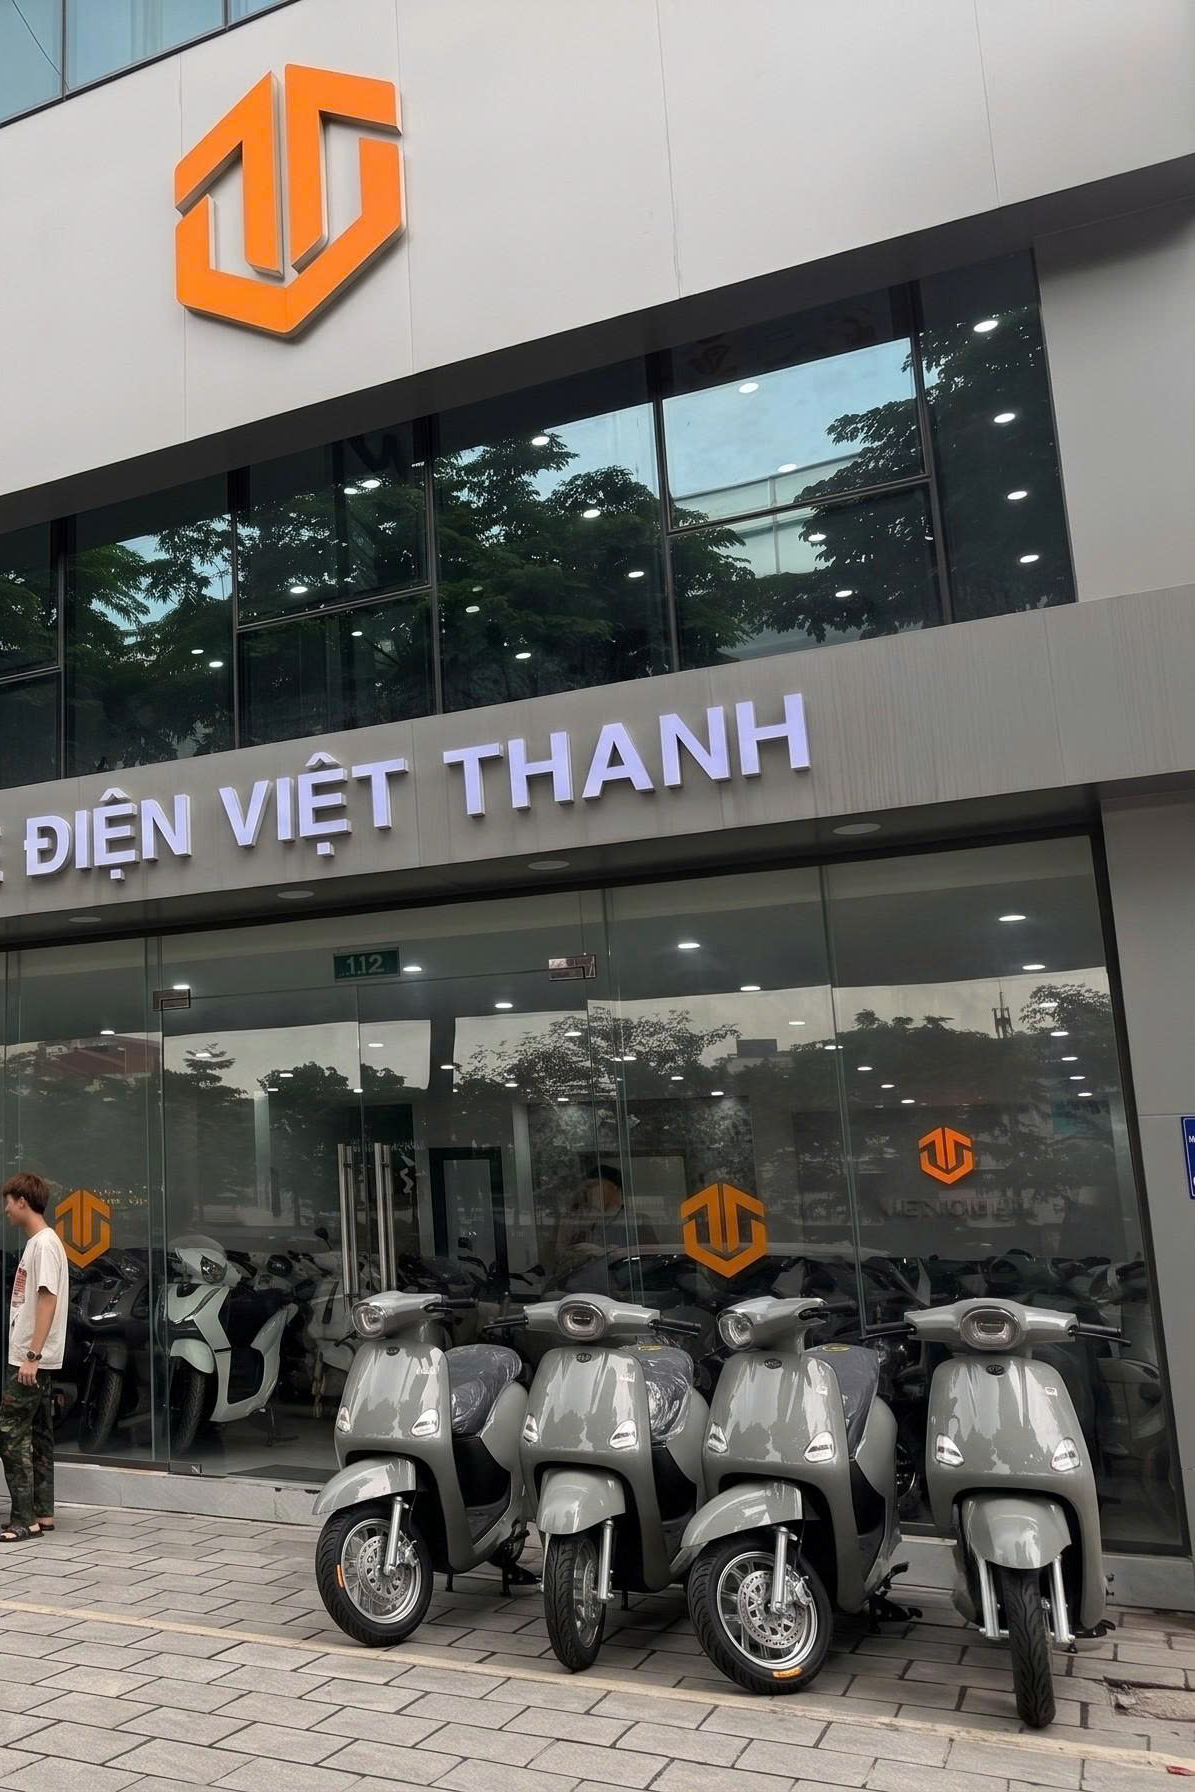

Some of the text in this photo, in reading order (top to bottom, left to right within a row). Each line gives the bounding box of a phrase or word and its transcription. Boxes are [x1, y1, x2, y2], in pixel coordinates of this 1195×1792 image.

[22, 787, 193, 881] ĐIỆN
[219, 751, 409, 858] VIỆT
[442, 692, 811, 817] THANH
